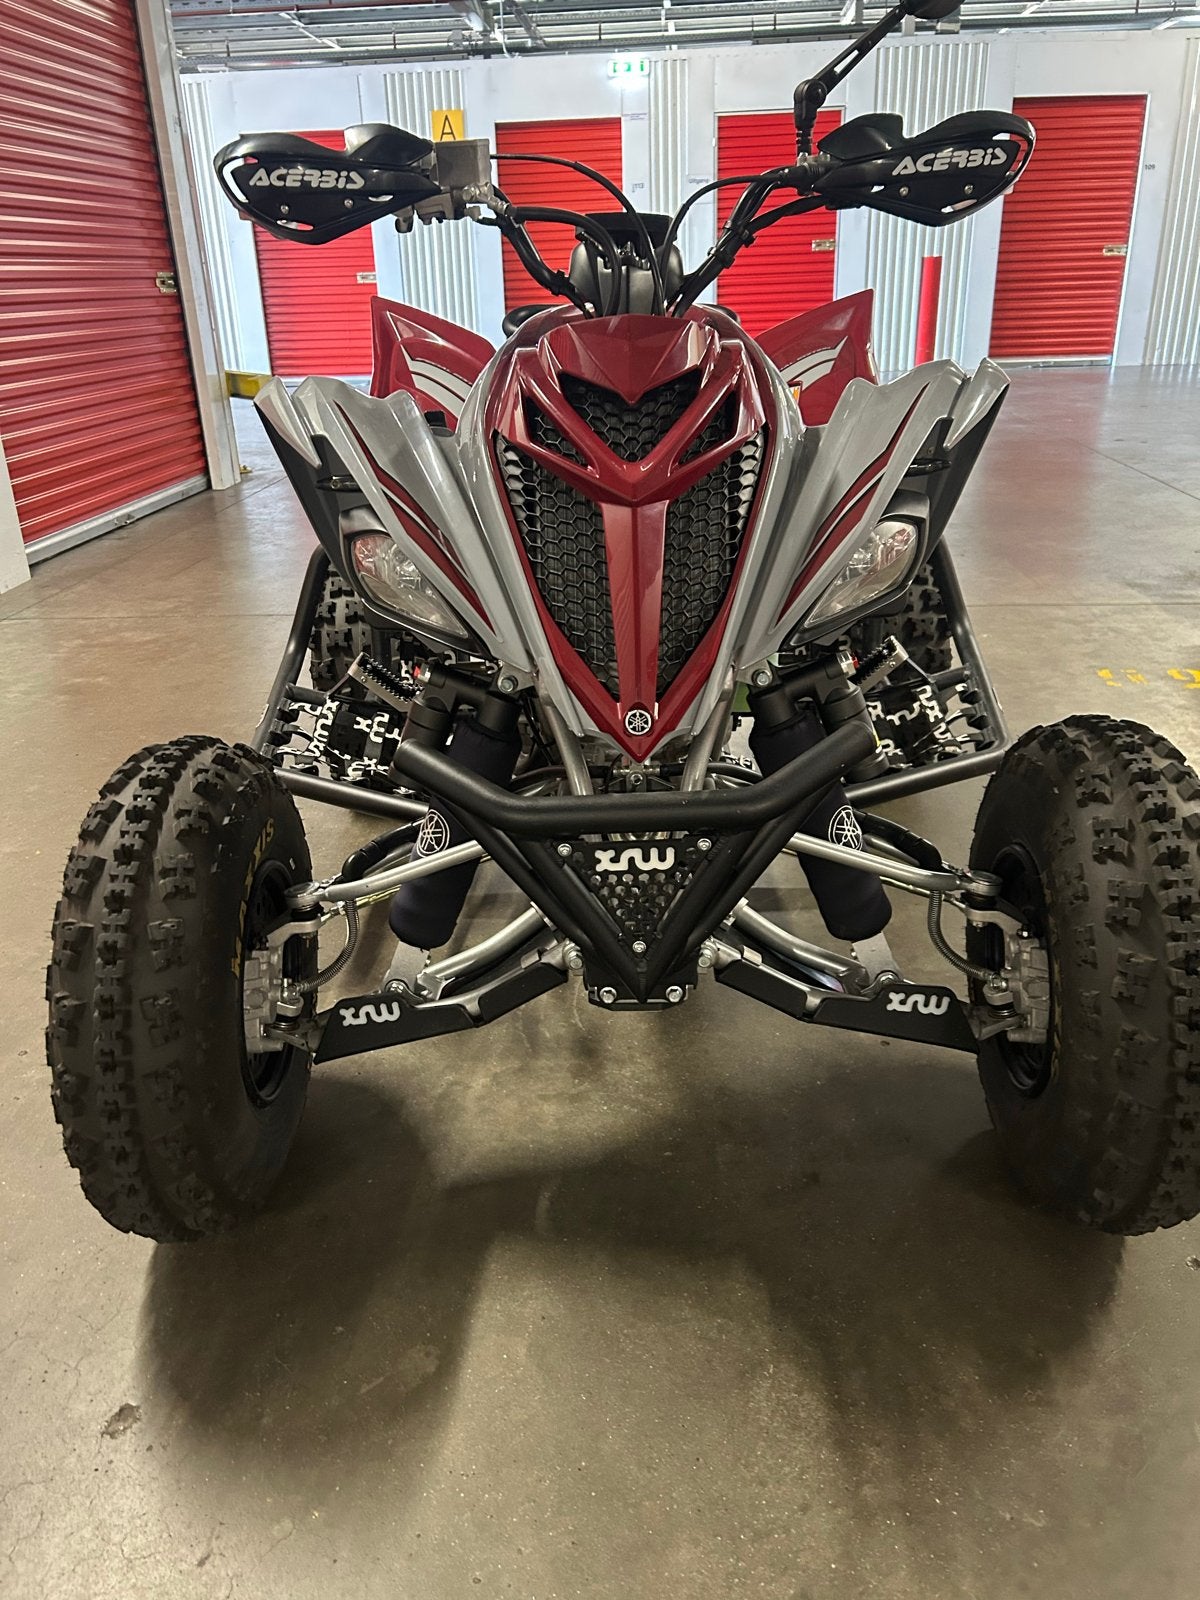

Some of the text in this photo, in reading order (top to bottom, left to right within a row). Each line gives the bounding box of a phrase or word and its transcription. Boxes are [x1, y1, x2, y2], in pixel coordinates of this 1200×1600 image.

[439, 114, 456, 141] A
[892, 147, 1008, 176] ACERBIS
[249, 167, 365, 190] ACERBIS
